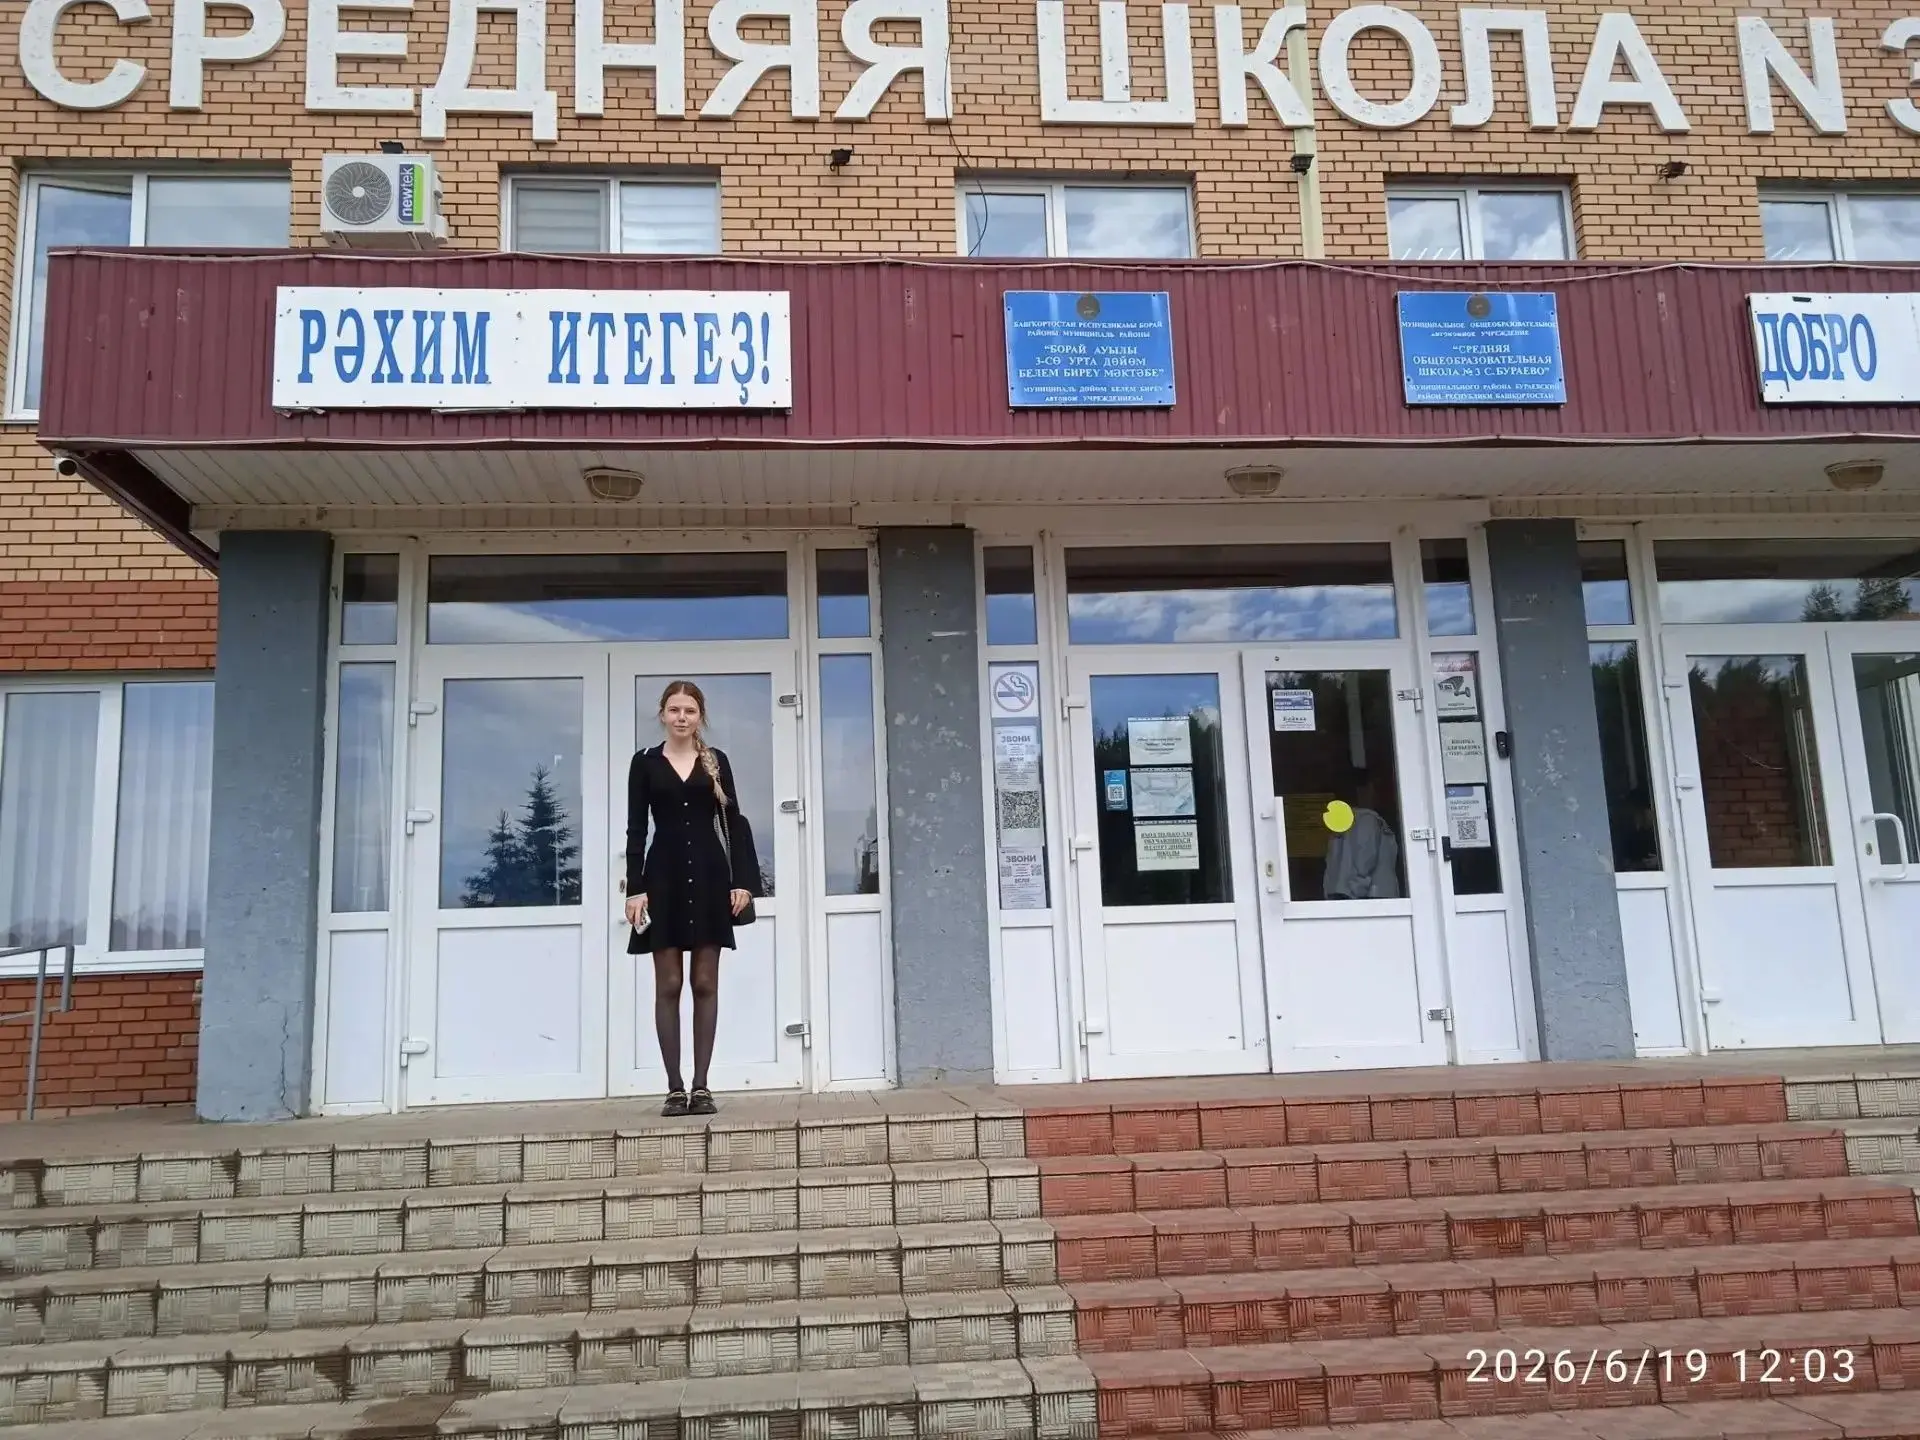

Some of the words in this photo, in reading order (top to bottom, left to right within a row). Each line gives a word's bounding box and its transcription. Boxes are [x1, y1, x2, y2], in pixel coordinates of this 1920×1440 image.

[18, 0, 951, 143] СРЕДНЯЯ
[1036, 0, 1692, 135] ШКОЛА
[1735, 16, 1846, 136] N
[400, 167, 414, 217] newtek
[1401, 321, 1466, 329] МУНИЦИПАЛЬНОЕ
[1470, 321, 1557, 329] ОБЩЕОБРАЗОВАТЕЛЬНОЕ
[1094, 346, 1138, 355] АУЫЛЫ
[1757, 312, 1877, 392] ДОБРО
[297, 308, 492, 384] РӘХИМ
[547, 311, 771, 405] ИТЕГЕҘ!
[1068, 357, 1098, 366] УРТА
[1103, 356, 1147, 367] ДӨЙӨМ
[1412, 355, 1552, 366] ОБЩЕОБРАЗОВАТЕЛЬНАЯ
[1019, 368, 1059, 378] БЕЛЕМ
[1418, 367, 1460, 377] ШКОЛА
[1475, 367, 1481, 377] 3
[1000, 735, 1031, 743] ЗВОНИ
[1004, 854, 1037, 863] ЗВОНИ
